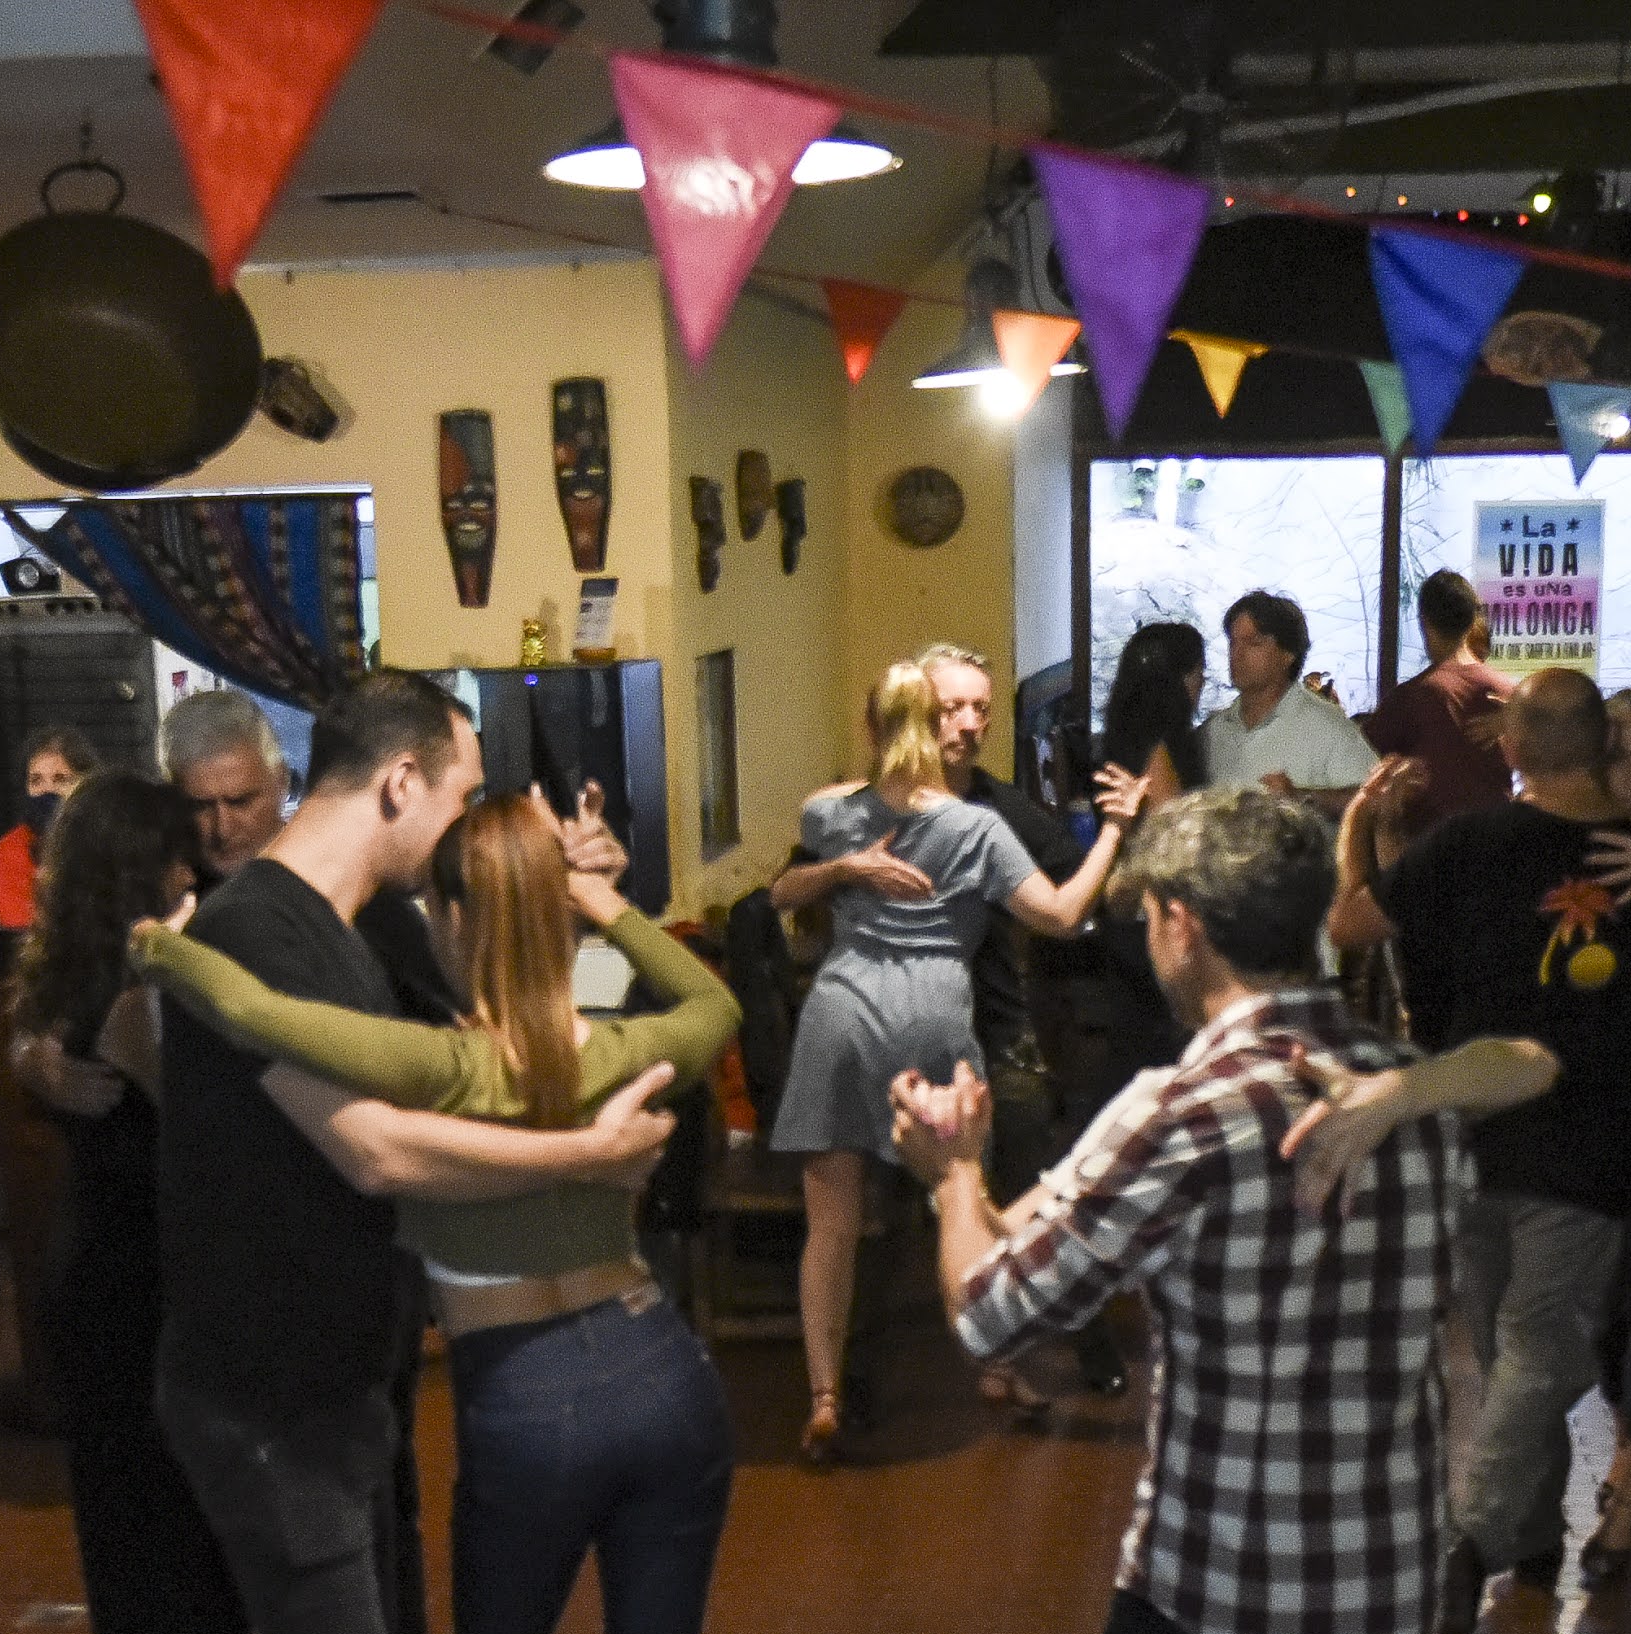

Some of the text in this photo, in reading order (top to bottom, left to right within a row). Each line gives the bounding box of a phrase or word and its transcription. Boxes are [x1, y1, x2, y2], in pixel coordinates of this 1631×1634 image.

[1522, 515, 1557, 538] La
[1503, 585, 1526, 597] es
[1483, 602, 1594, 636] MILONGA
